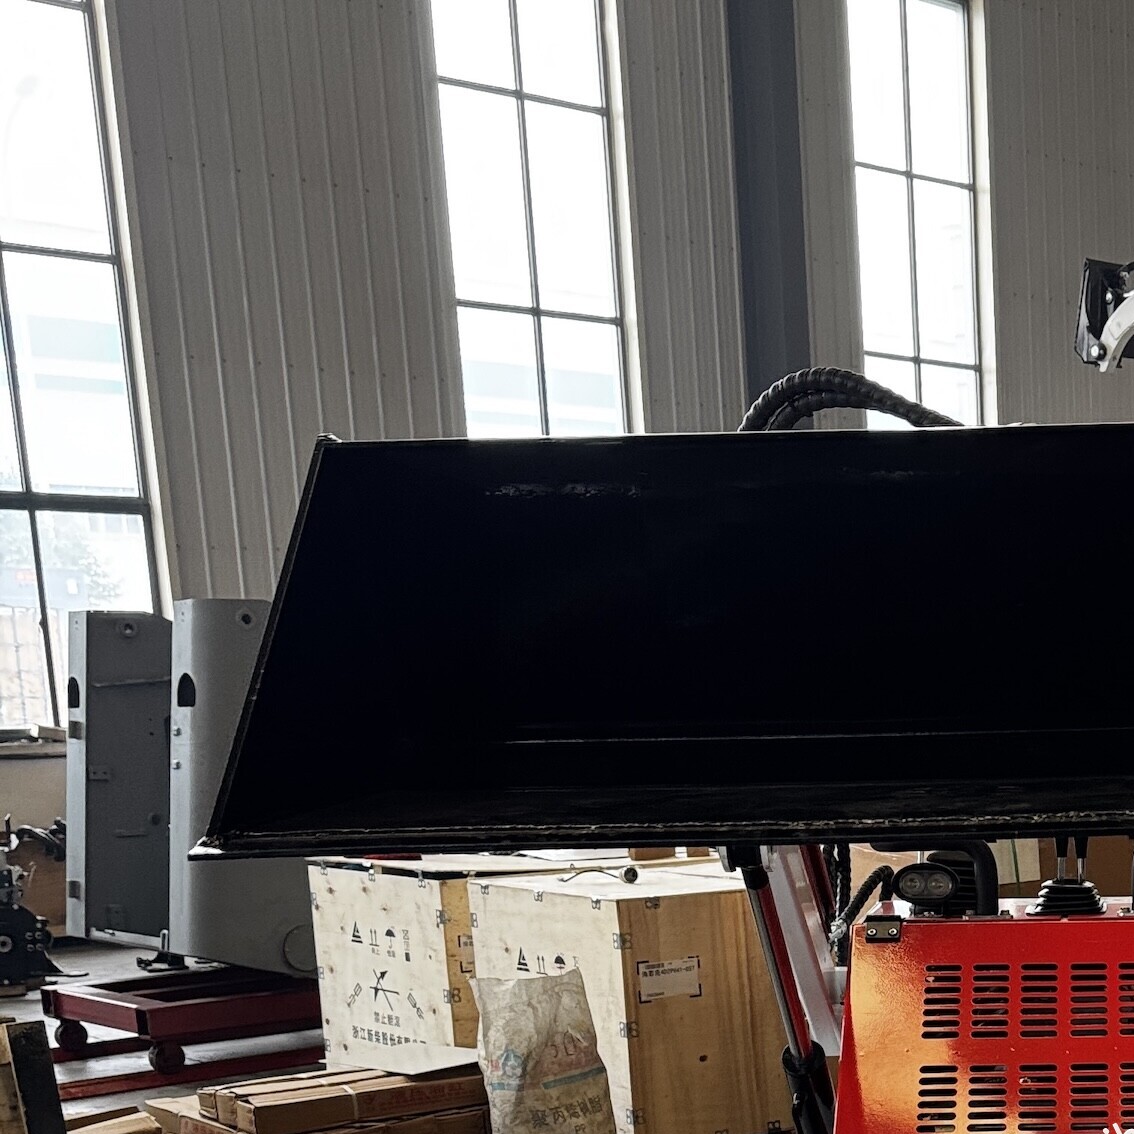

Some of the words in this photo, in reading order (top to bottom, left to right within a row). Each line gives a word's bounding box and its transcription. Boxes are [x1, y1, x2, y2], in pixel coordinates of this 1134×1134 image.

[352, 1025, 427, 1047] 浙江新柴股份有限
